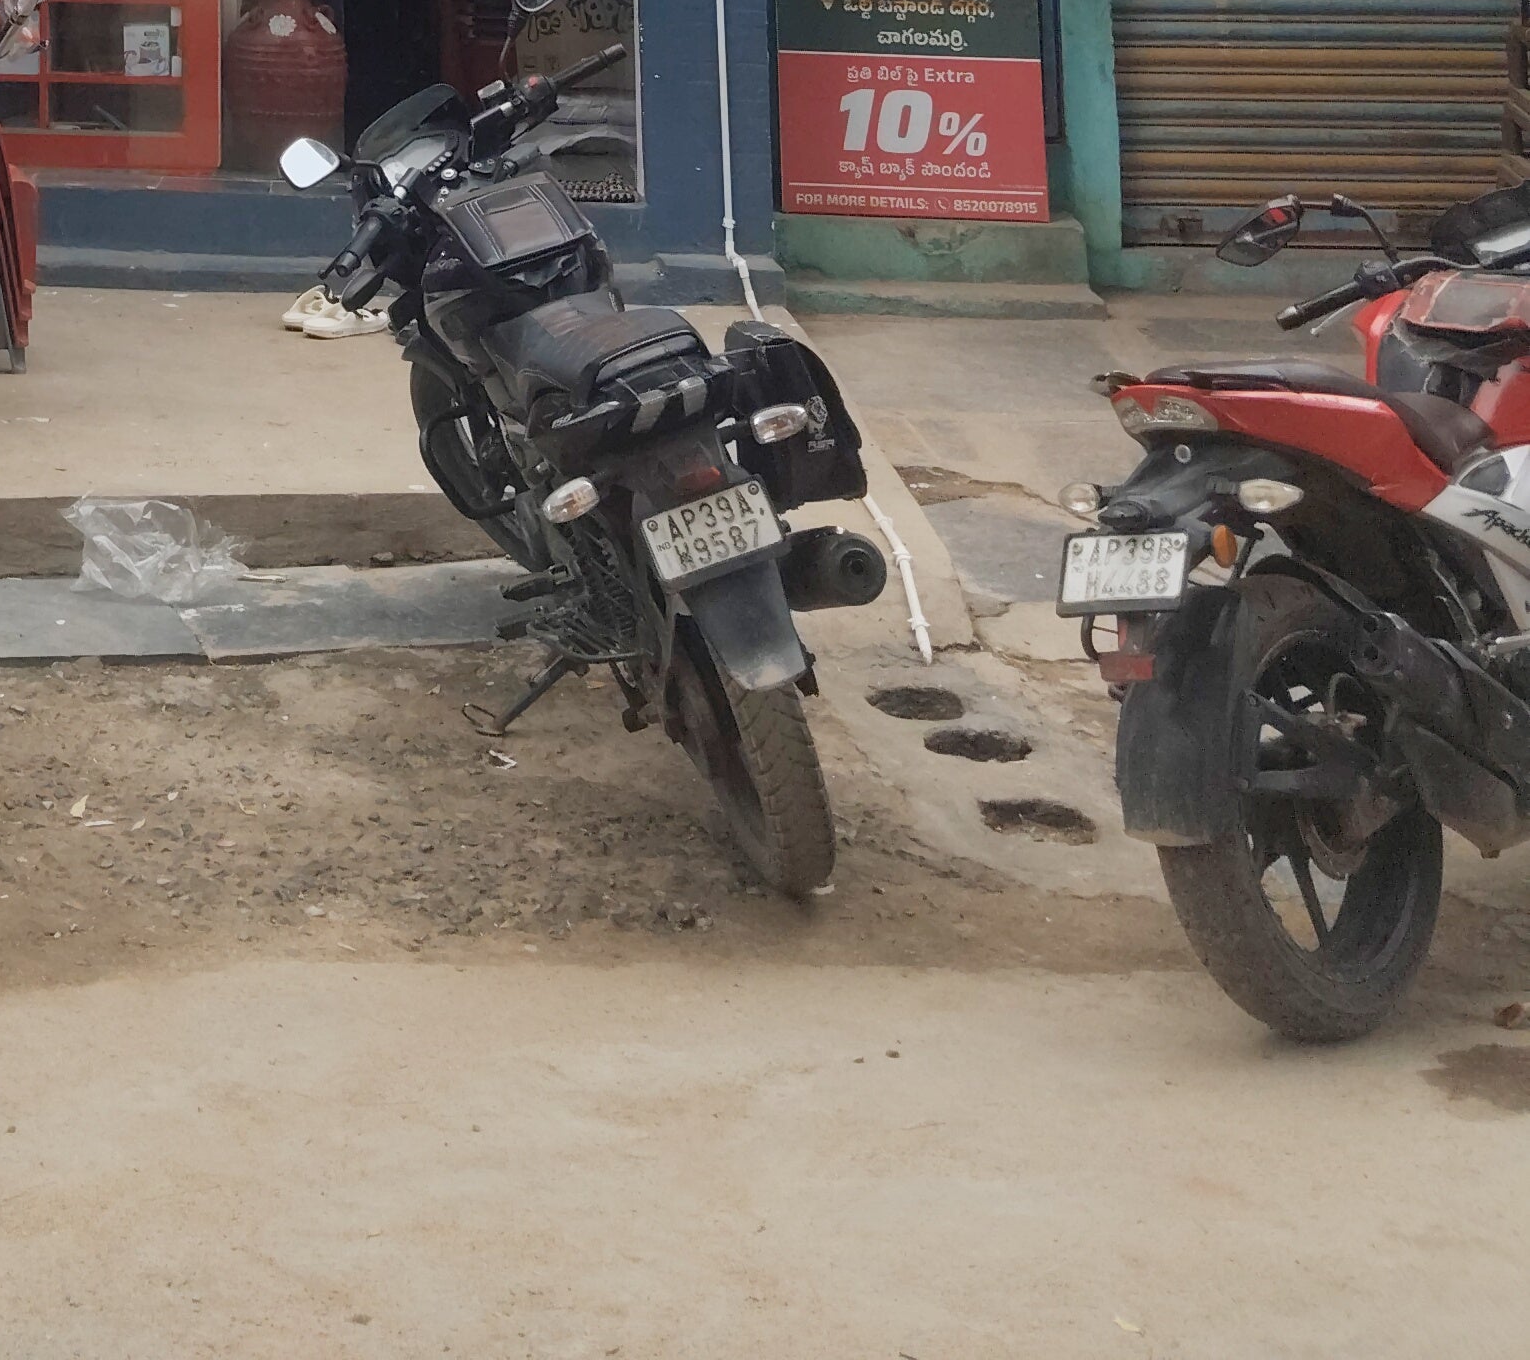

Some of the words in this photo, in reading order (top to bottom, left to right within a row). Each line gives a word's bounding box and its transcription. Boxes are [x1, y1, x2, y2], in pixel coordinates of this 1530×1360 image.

[924, 68, 975, 83] Extra
[839, 89, 987, 157] 10%
[796, 194, 822, 205] FOR
[826, 195, 866, 207] MORE
